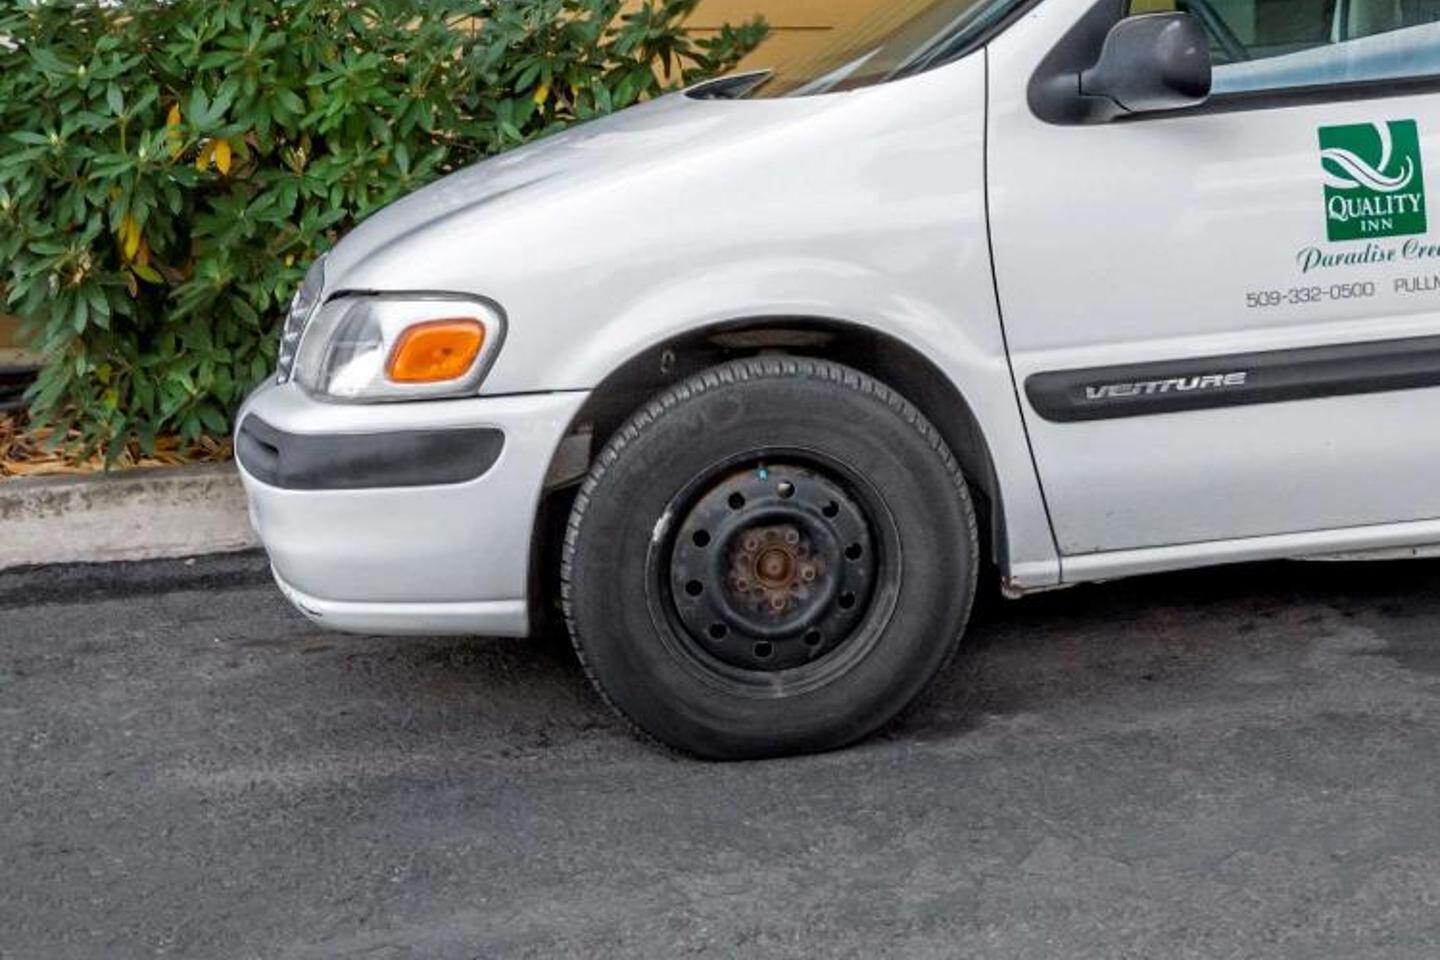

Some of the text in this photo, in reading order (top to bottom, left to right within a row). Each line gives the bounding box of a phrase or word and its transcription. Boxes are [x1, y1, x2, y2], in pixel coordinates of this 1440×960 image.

[1328, 192, 1422, 221] QUALITY
[1360, 218, 1393, 232] INN
[1296, 244, 1396, 273] Paradise
[1246, 281, 1375, 308] 509-332-0500
[1086, 371, 1248, 399] VENTURE
